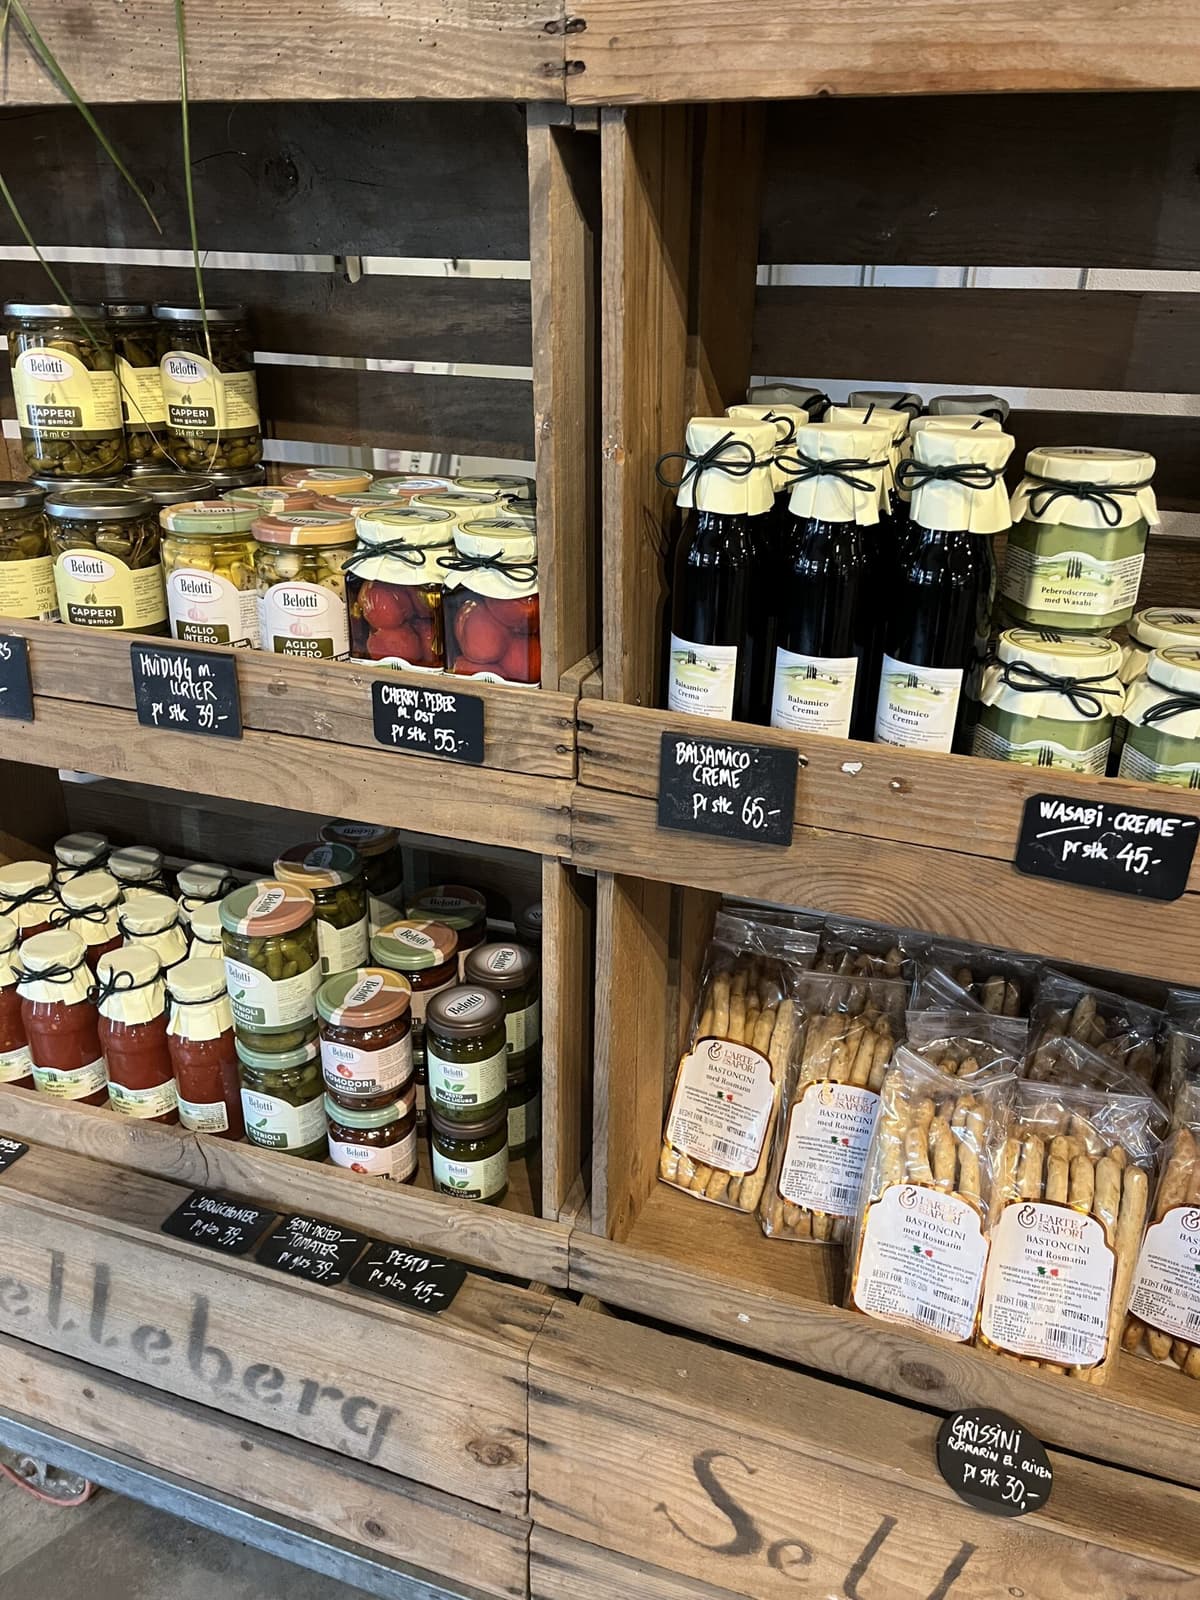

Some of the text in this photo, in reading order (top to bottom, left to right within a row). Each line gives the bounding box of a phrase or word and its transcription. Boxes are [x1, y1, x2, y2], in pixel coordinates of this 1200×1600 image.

[31, 359, 63, 374] Belotti
[168, 361, 198, 376] Belotti
[171, 407, 209, 418] CAPPERI
[71, 557, 104, 575] Belotti
[180, 577, 212, 595] Belotti
[282, 592, 318, 608] Belotti
[1044, 596, 1091, 607] med Wasabi
[71, 606, 117, 618] CAPPERI
[185, 624, 215, 635] AGLIO
[183, 632, 218, 644] INTERO
[285, 639, 318, 650] AGLIO
[282, 648, 323, 659] INTERO
[674, 679, 709, 695] Balsamico
[677, 688, 700, 701] Crema
[787, 694, 829, 708] Balsamico
[414, 710, 436, 725] OST
[791, 704, 819, 716] Crema
[888, 702, 929, 719] Balsamico
[892, 712, 919, 726] Crema
[692, 764, 742, 789] CREME
[258, 892, 282, 912] Belotti
[400, 928, 431, 946] Belotti
[498, 950, 514, 971] Belotti
[227, 963, 251, 983] Belotti
[353, 976, 380, 1004] Belotti
[448, 993, 482, 1016] Belotti
[332, 1046, 354, 1060] Belotti
[706, 1074, 720, 1084] med
[708, 1063, 756, 1085] BASTONCINI
[249, 1096, 273, 1112] Belotti
[819, 1109, 872, 1126] BASTONCINI
[817, 1119, 869, 1135] med Rosmarin
[346, 1146, 369, 1158] Belotti
[905, 1215, 967, 1242] BASTONCINI
[1041, 1224, 1084, 1240] SAPORI
[288, 1231, 340, 1260] TOMATER
[903, 1227, 962, 1251] med Rosmarin
[1026, 1234, 1091, 1255] BASTONCINI
[386, 1249, 430, 1273] PESTO
[1024, 1247, 1087, 1266] med Rosmarin
